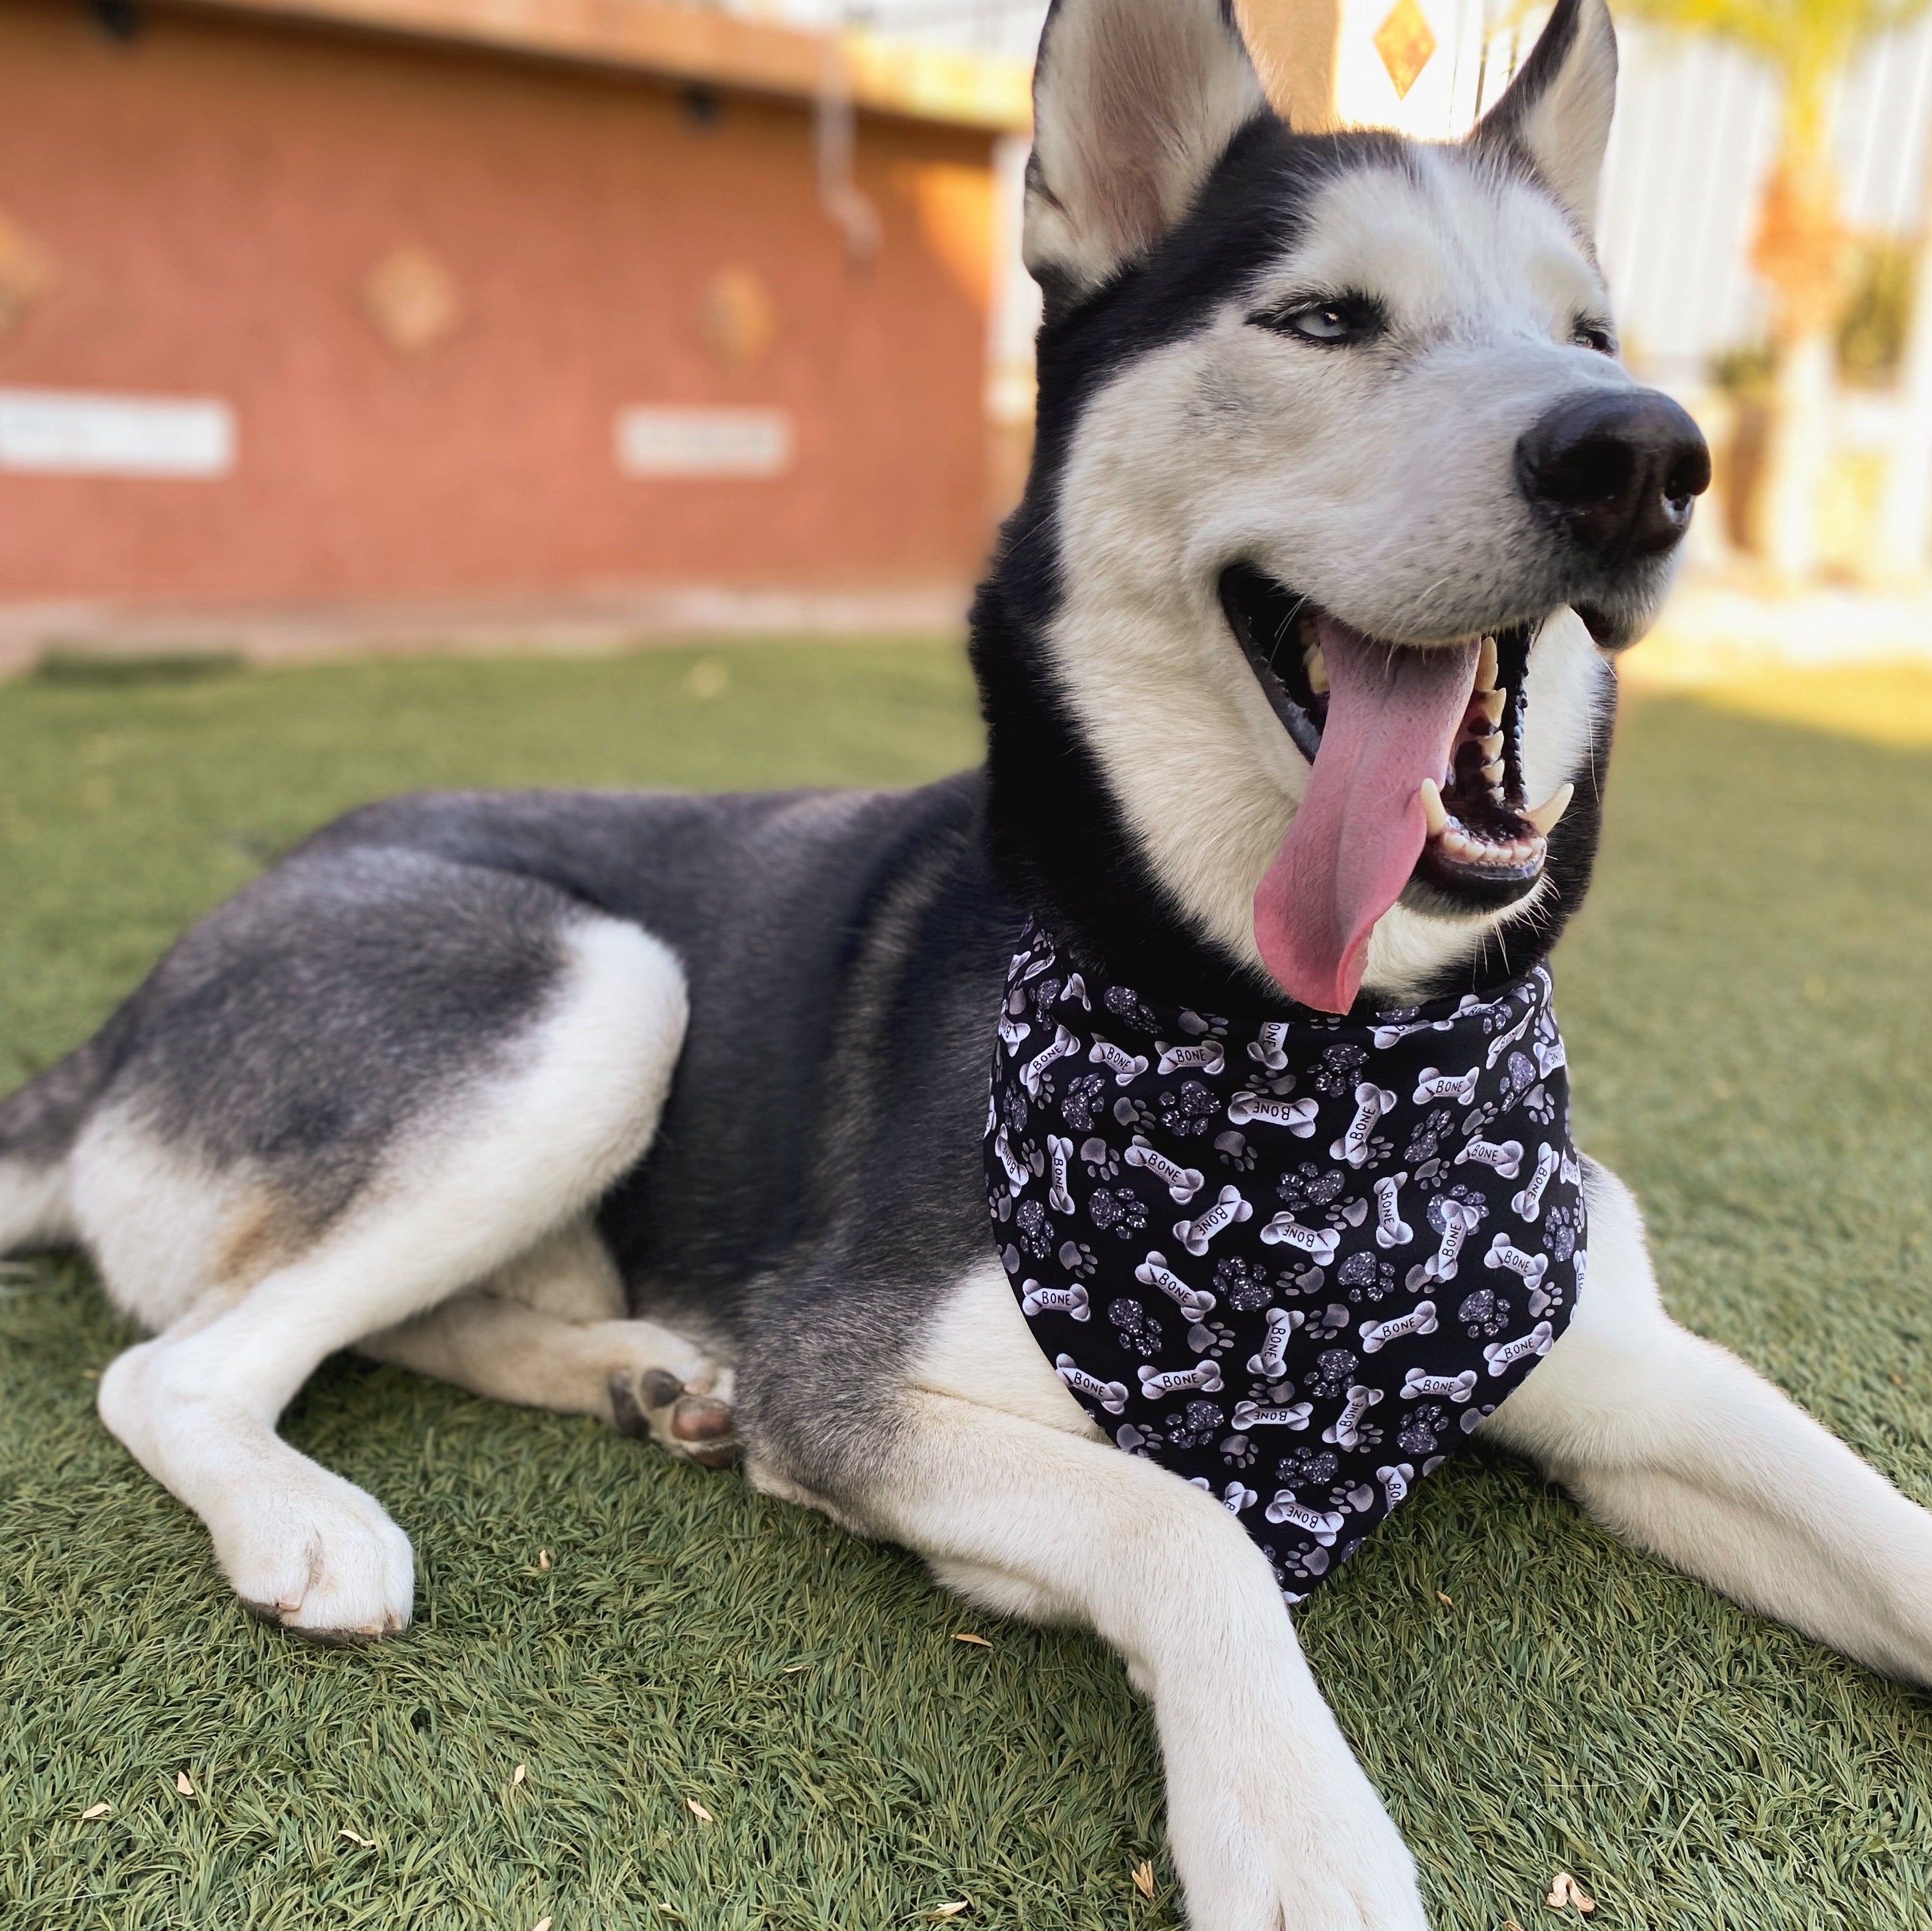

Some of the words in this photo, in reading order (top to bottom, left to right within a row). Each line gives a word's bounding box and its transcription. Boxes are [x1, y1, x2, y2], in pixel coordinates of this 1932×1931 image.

[1263, 1024, 1281, 1047] ONE
[1033, 1045, 1062, 1070] BONE
[1107, 1046, 1130, 1070] BONE
[1176, 1048, 1205, 1062] BONE
[1436, 1080, 1463, 1094] BONE
[1253, 1101, 1290, 1120] BONE
[1349, 1106, 1375, 1140] BONE
[1471, 1146, 1498, 1160] BONE
[1054, 1157, 1064, 1192] BONE
[1148, 1153, 1181, 1182] BONE
[1527, 1166, 1547, 1199] BONE
[1381, 1191, 1395, 1225] BONE
[1199, 1206, 1228, 1236] BONE
[1283, 1225, 1314, 1247] BONE
[1442, 1222, 1462, 1258] BONE
[1504, 1250, 1531, 1272] BONE
[1041, 1292, 1071, 1306] BONE
[1158, 1272, 1191, 1303] BONE
[1382, 1317, 1415, 1337] BONE
[1264, 1326, 1286, 1358] BONE
[1505, 1338, 1535, 1360] BONE
[1073, 1372, 1105, 1397] BONE
[1163, 1372, 1199, 1388] BONE
[1423, 1379, 1455, 1392] BONE
[1253, 1411, 1287, 1422] BONE
[1340, 1400, 1364, 1426] BONE
[1388, 1483, 1401, 1502] BO
[1286, 1504, 1318, 1528] BONE
